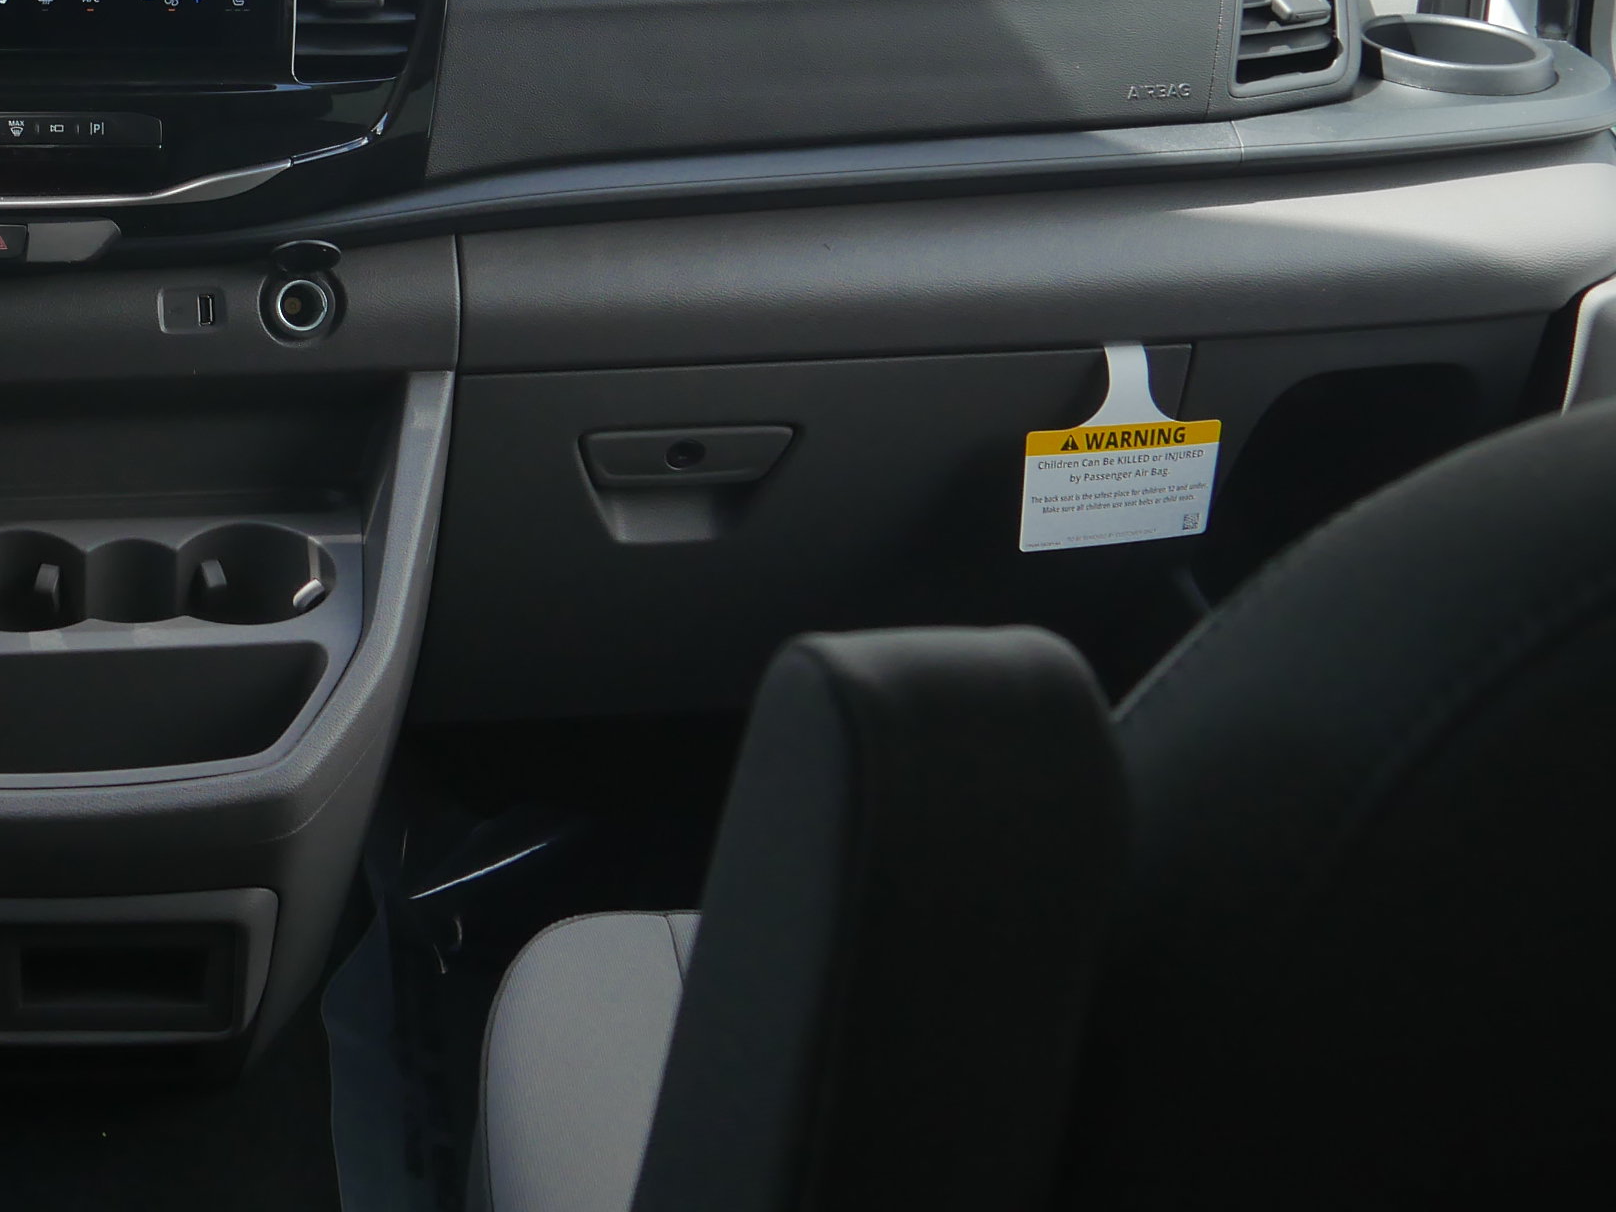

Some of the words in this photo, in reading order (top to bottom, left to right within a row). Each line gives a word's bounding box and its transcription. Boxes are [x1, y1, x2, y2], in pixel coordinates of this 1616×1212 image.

[1085, 427, 1186, 450] WARNING
[1038, 460, 1079, 470] Children
[1082, 458, 1100, 467] Can
[1103, 457, 1115, 465] Be
[1117, 454, 1150, 465] KILLED
[1165, 449, 1204, 461] INJURED
[1069, 474, 1081, 484] by
[1084, 471, 1132, 482] Passenger
[1135, 469, 1148, 478] Air
